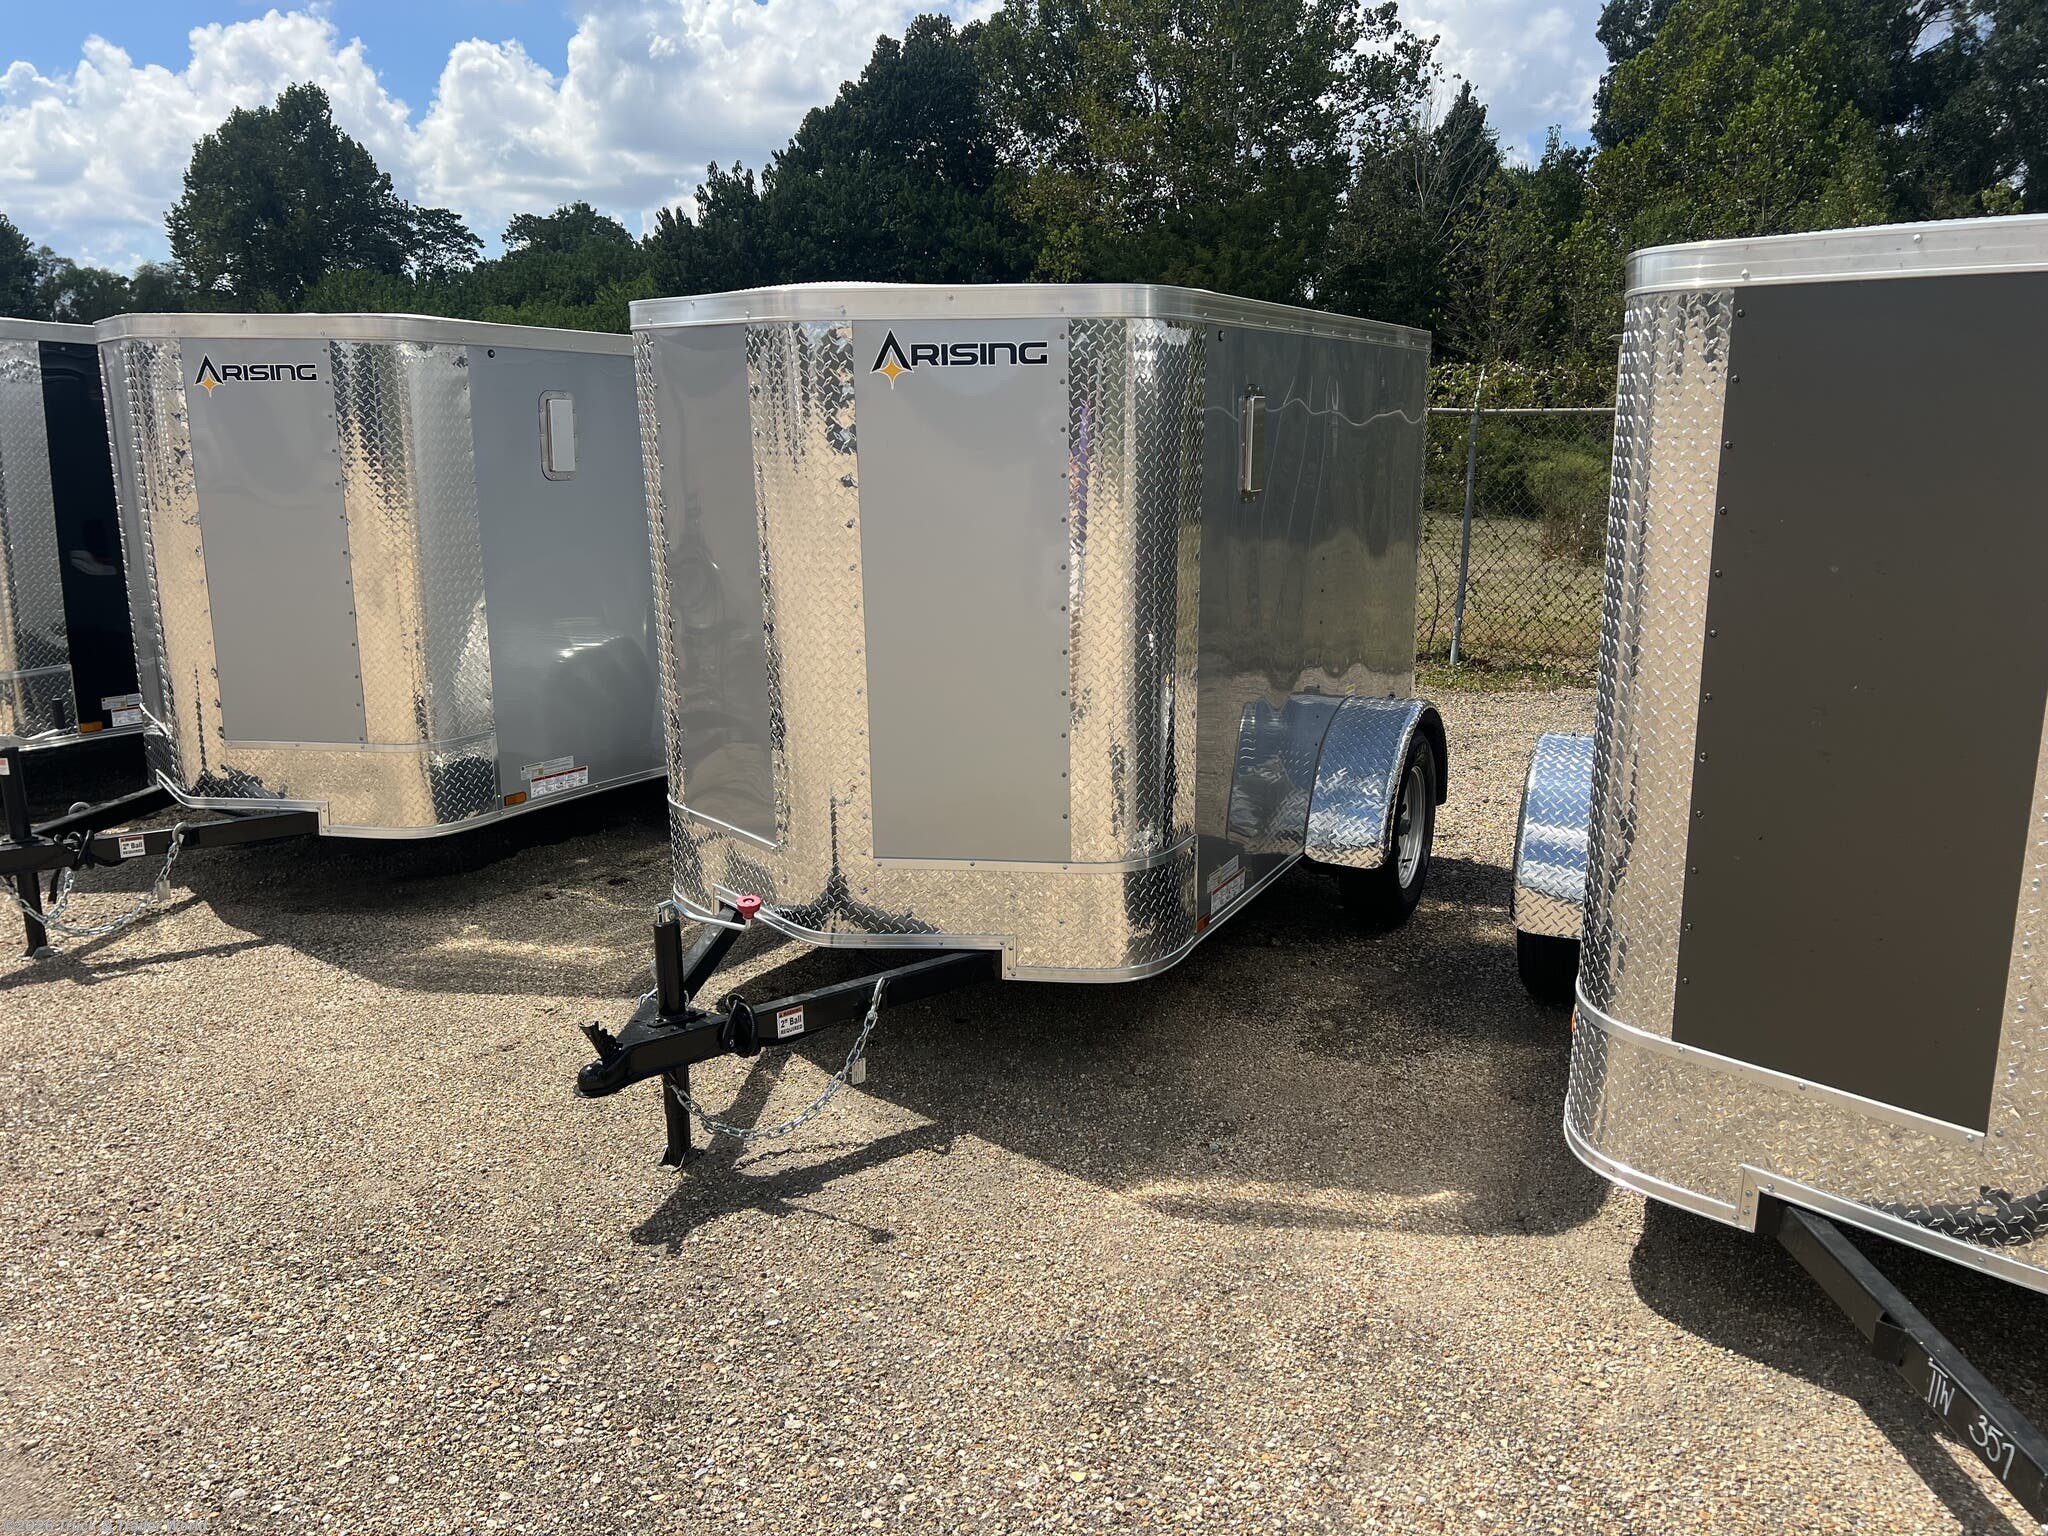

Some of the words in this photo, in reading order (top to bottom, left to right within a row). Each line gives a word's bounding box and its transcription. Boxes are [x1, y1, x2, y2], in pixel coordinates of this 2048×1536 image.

[870, 328, 1048, 374] ARISING
[194, 353, 318, 386] ARISING
[780, 1024, 802, 1035] REQUIRED
[790, 1015, 802, 1025] Ball
[1968, 1414, 2015, 1481] 357
